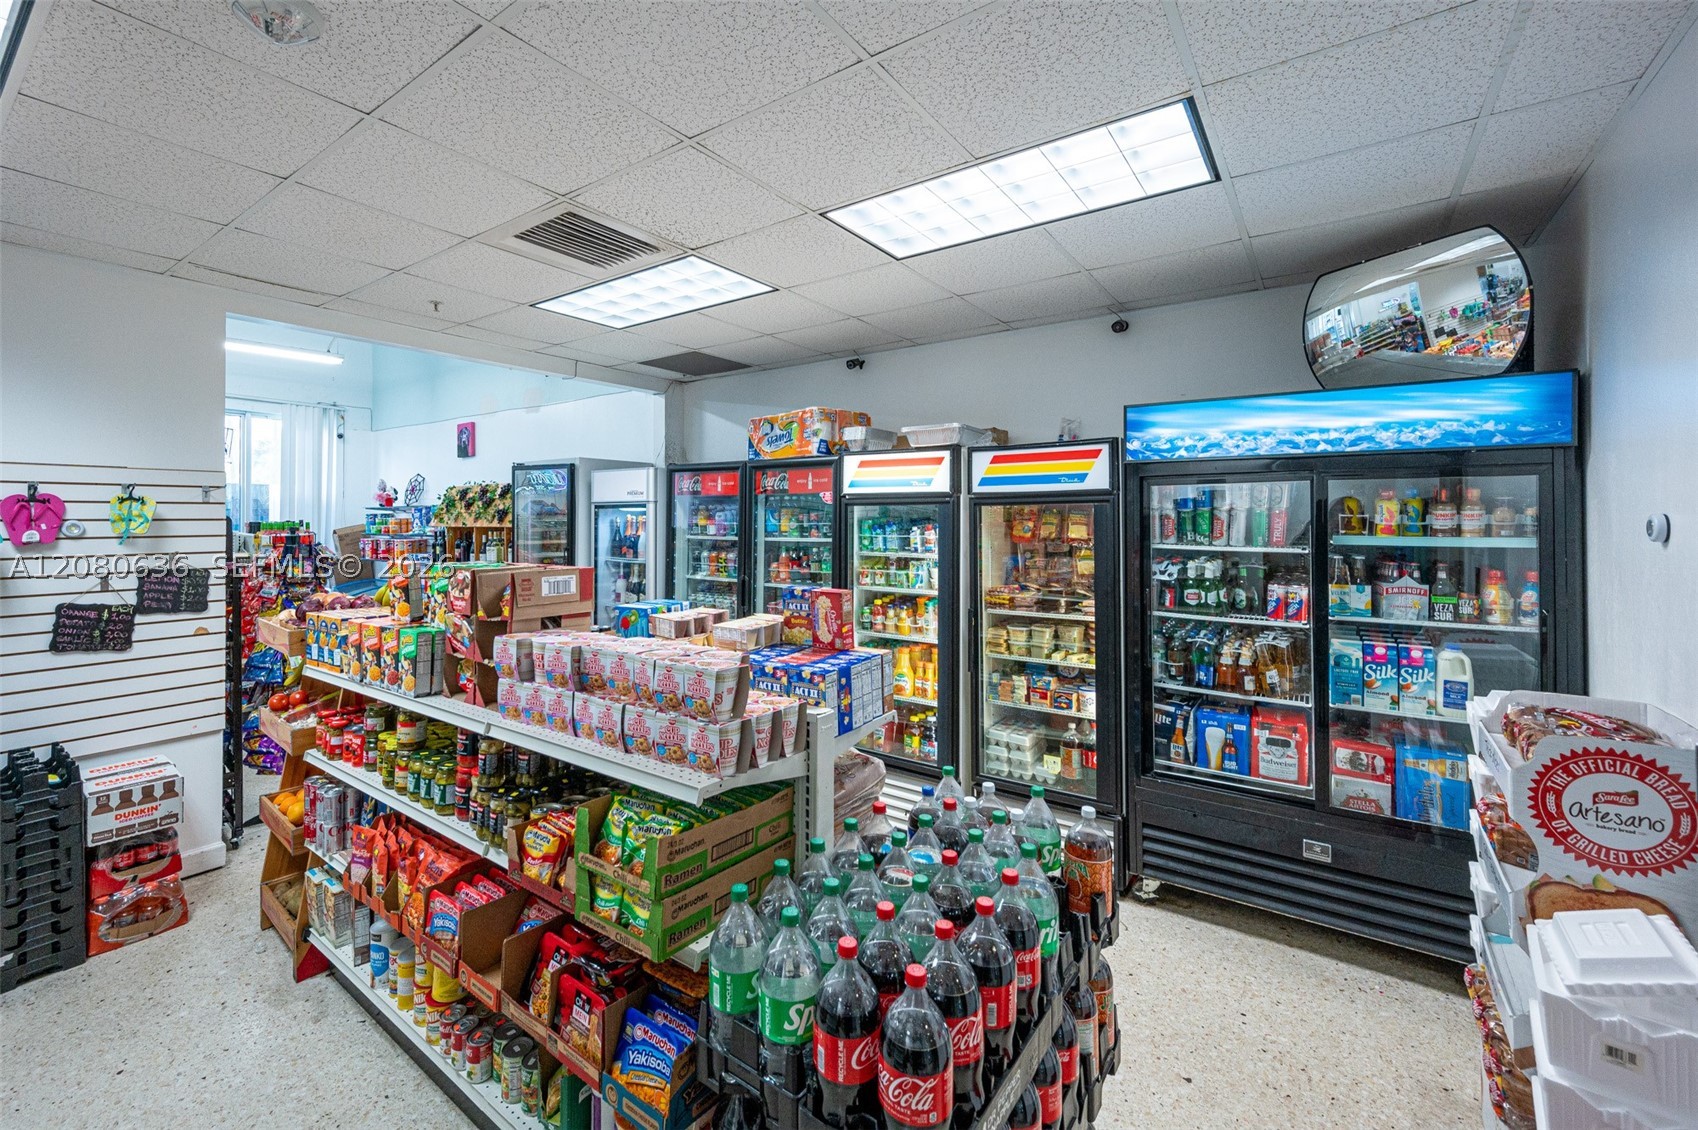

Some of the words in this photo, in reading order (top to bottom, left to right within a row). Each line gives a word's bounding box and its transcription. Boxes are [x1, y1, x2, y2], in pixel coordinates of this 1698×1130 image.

[1273, 518, 1282, 542] TRULY
[143, 592, 174, 600] APPLE
[1387, 586, 1425, 595] SMIRNOFF
[788, 602, 801, 610] ACT
[1434, 603, 1454, 612] VEZA
[1459, 599, 1474, 607] VEZA
[61, 608, 98, 618] ORANGE
[1434, 612, 1452, 621] SUR
[1458, 607, 1474, 615] SUR
[790, 617, 809, 625] Butter
[1364, 664, 1398, 680] Silk
[1400, 668, 1436, 684] Silk
[758, 681, 772, 691] ACT
[772, 683, 781, 692] II
[794, 687, 809, 697] ACT
[809, 688, 818, 698] II
[1402, 693, 1427, 701] Almond
[1154, 713, 1172, 725] Lite
[1261, 757, 1297, 768] Budweiser
[1547, 771, 1573, 790] THE
[1570, 759, 1640, 779] OFFICIAL
[1645, 772, 1689, 809] BREAD
[625, 798, 656, 812] Maruchan
[1349, 798, 1376, 807] STELLA
[114, 803, 161, 821] DUNKIN'
[638, 825, 672, 836] Maruchan
[1596, 823, 1617, 833] bakery
[1618, 826, 1637, 835] bread
[674, 838, 705, 856] Maruchan
[1551, 819, 1573, 837] OF
[1567, 831, 1628, 864] GRILLED
[1633, 837, 1687, 866] CHEESE
[613, 870, 628, 884] Chili
[664, 863, 703, 886] Ramen
[668, 917, 706, 944] Ramen
[615, 932, 630, 946] Chili
[662, 1013, 696, 1040] Maruchan
[643, 1027, 676, 1058] Maruchan
[628, 1050, 671, 1077] Yakisoba
[894, 1105, 911, 1115] TASTE
